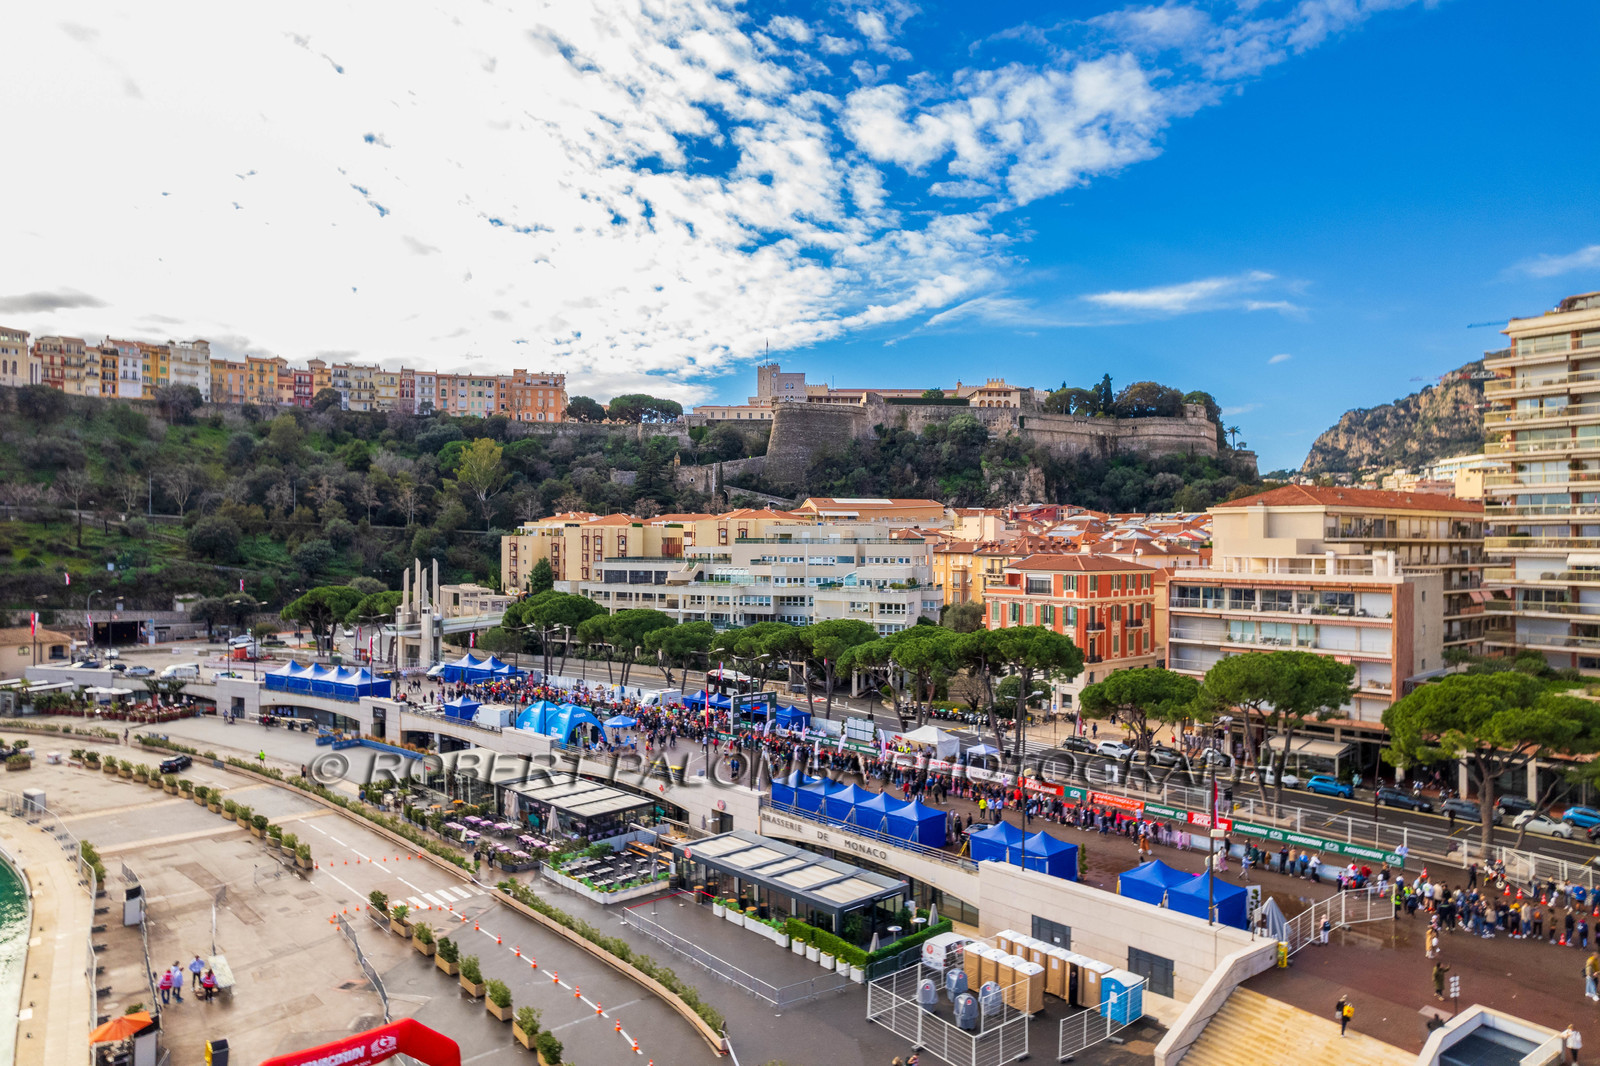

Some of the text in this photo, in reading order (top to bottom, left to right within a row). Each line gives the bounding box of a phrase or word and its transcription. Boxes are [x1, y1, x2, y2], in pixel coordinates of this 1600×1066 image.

[761, 813, 887, 860] BRASSERIE DE MONACO
